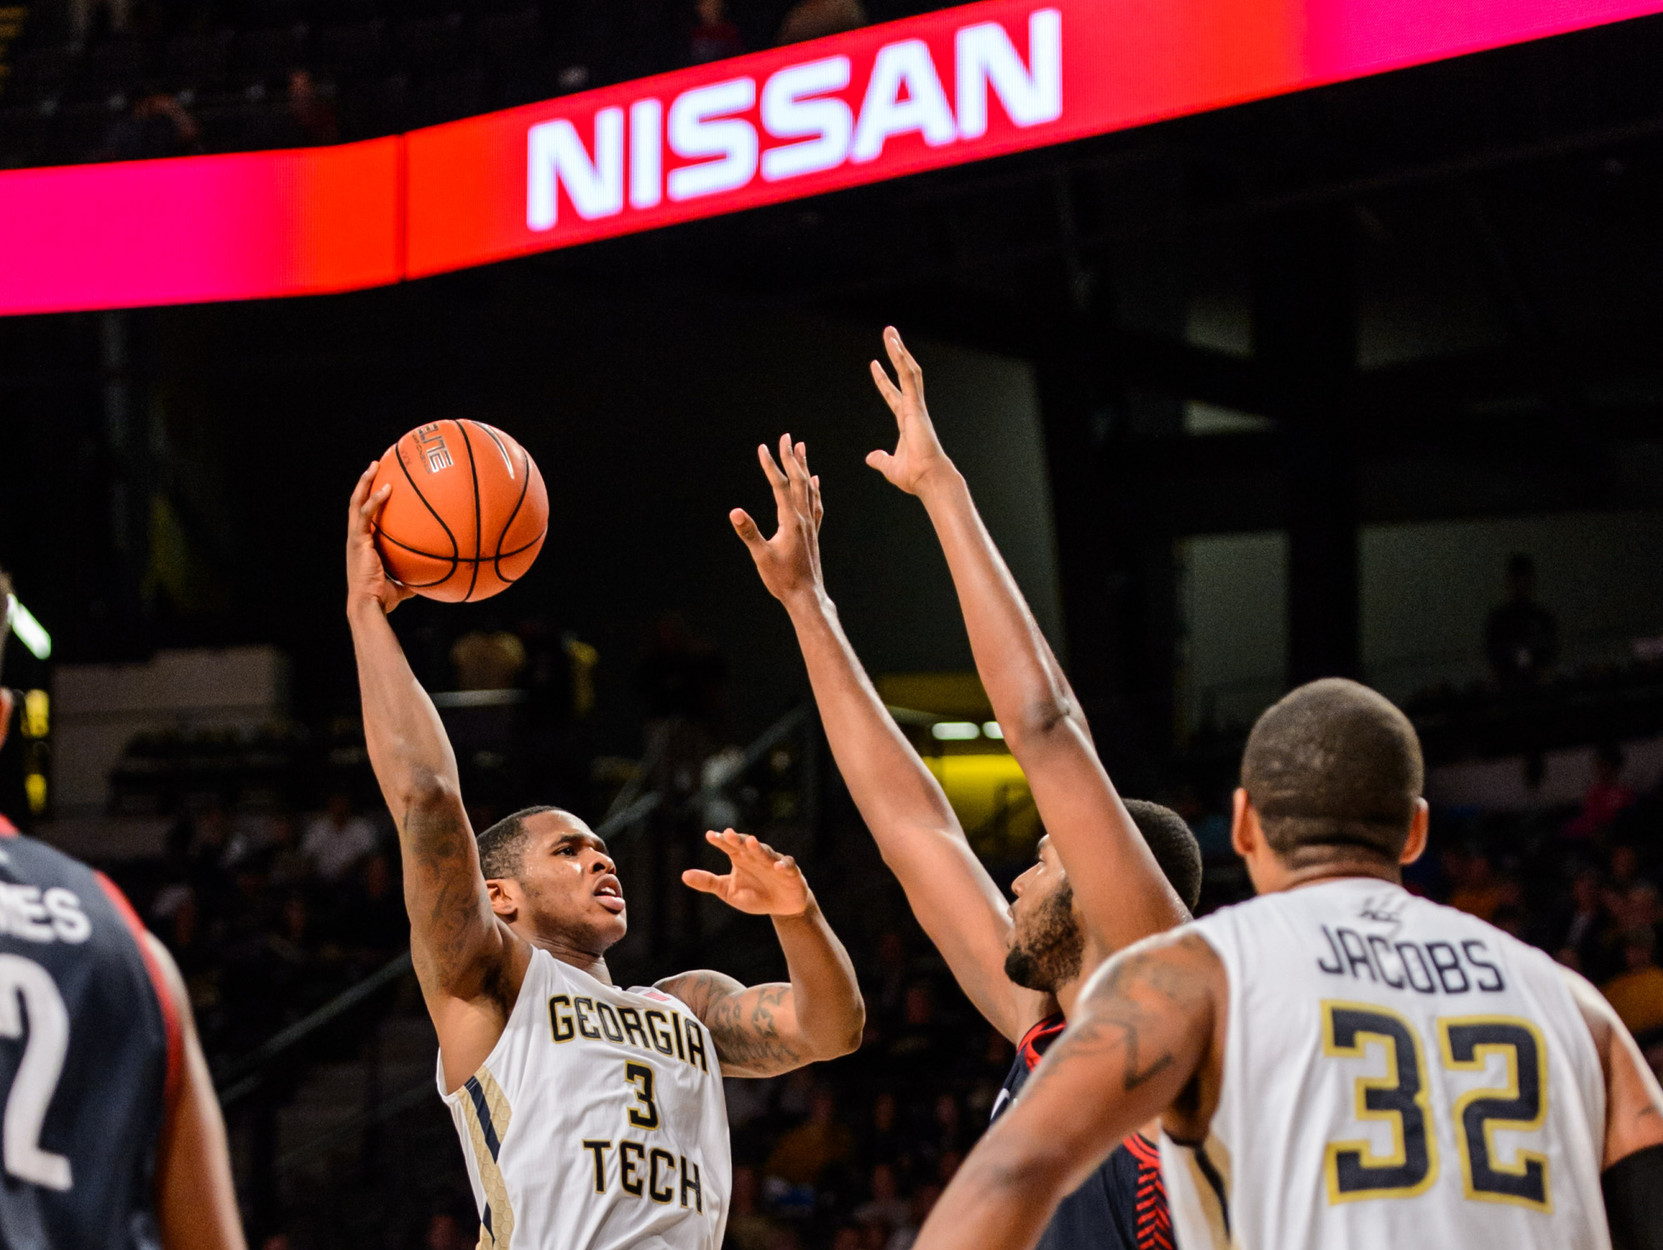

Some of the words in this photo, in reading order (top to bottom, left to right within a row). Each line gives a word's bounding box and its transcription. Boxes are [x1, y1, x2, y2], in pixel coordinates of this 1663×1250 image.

[526, 8, 1062, 231] NISSAN
[0, 882, 93, 943] ES
[1318, 924, 1504, 993] JACOBS
[549, 994, 709, 1075] GEORGIA
[624, 1059, 660, 1131] 3
[1320, 999, 1555, 1215] 32
[582, 1139, 703, 1216] TECH
